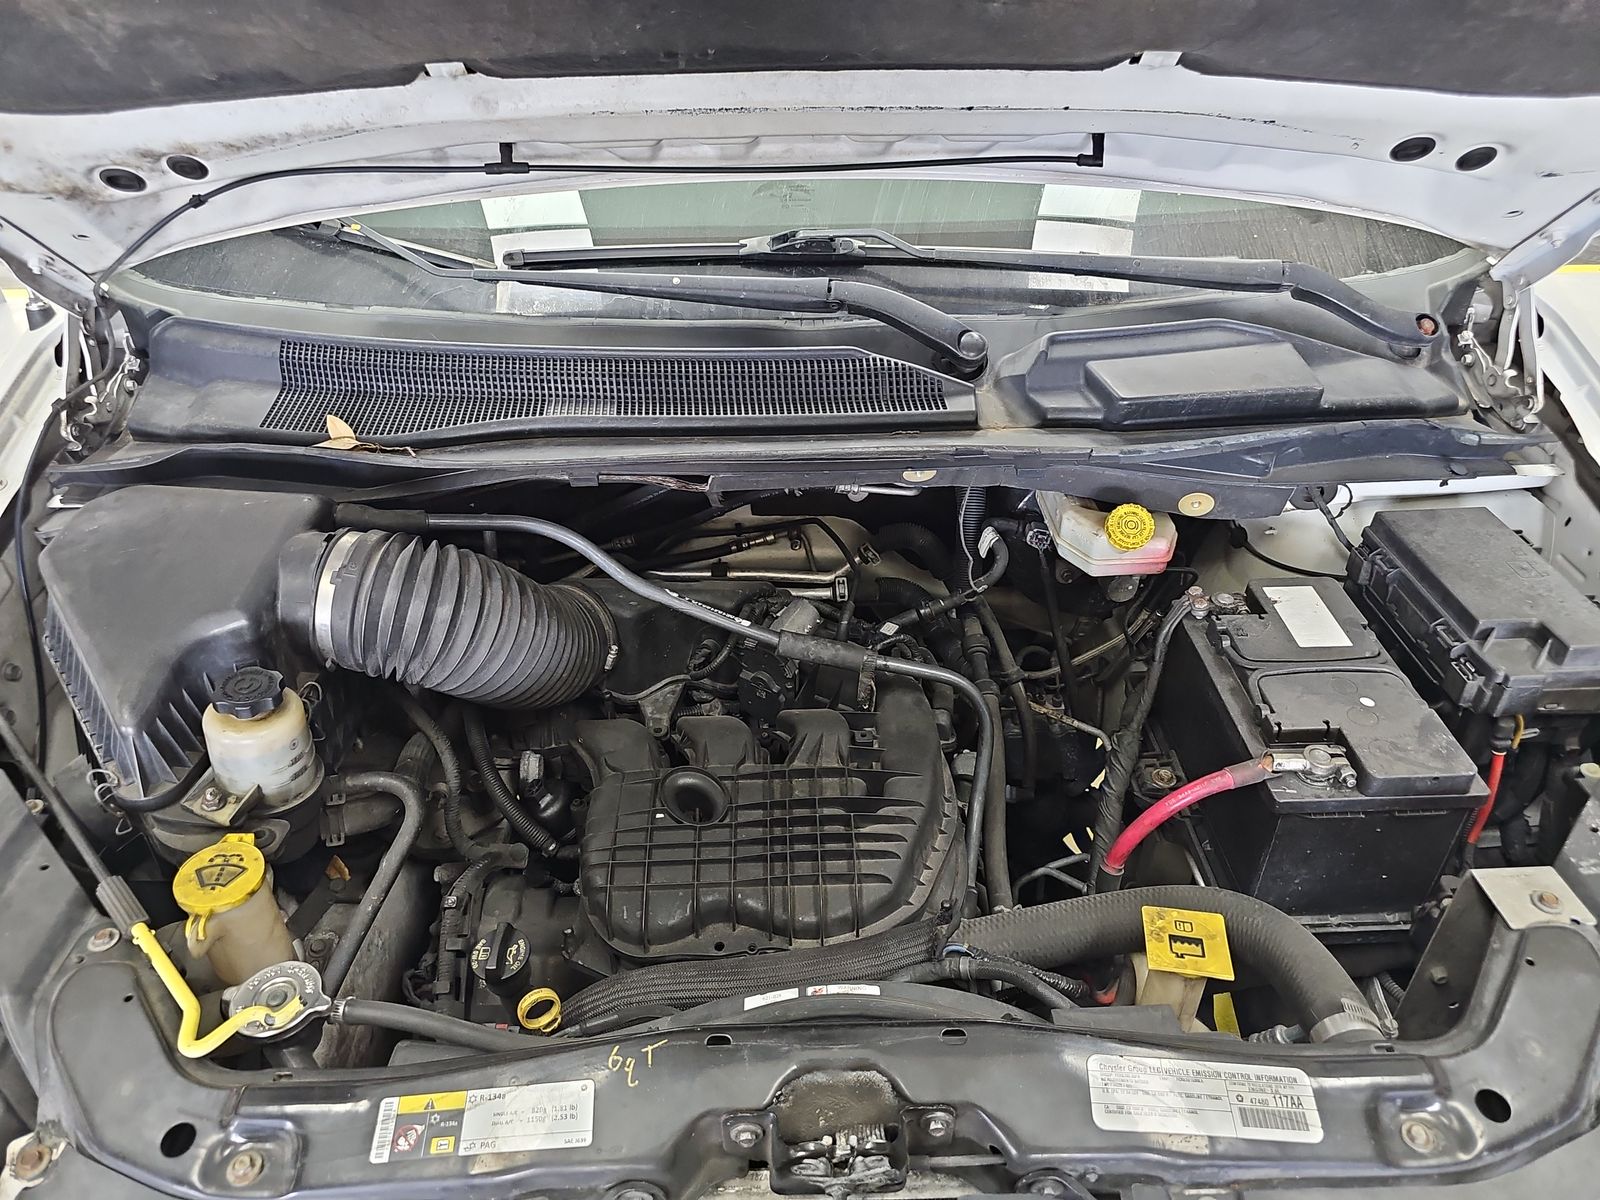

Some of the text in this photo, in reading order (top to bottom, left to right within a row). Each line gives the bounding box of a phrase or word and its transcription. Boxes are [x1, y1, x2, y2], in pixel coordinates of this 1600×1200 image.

[510, 939, 526, 970] ENGINE OIL
[1164, 1067, 1298, 1083] VEHICLE EMISSION CONTROL INFORMATION
[480, 1140, 497, 1149] PAG
